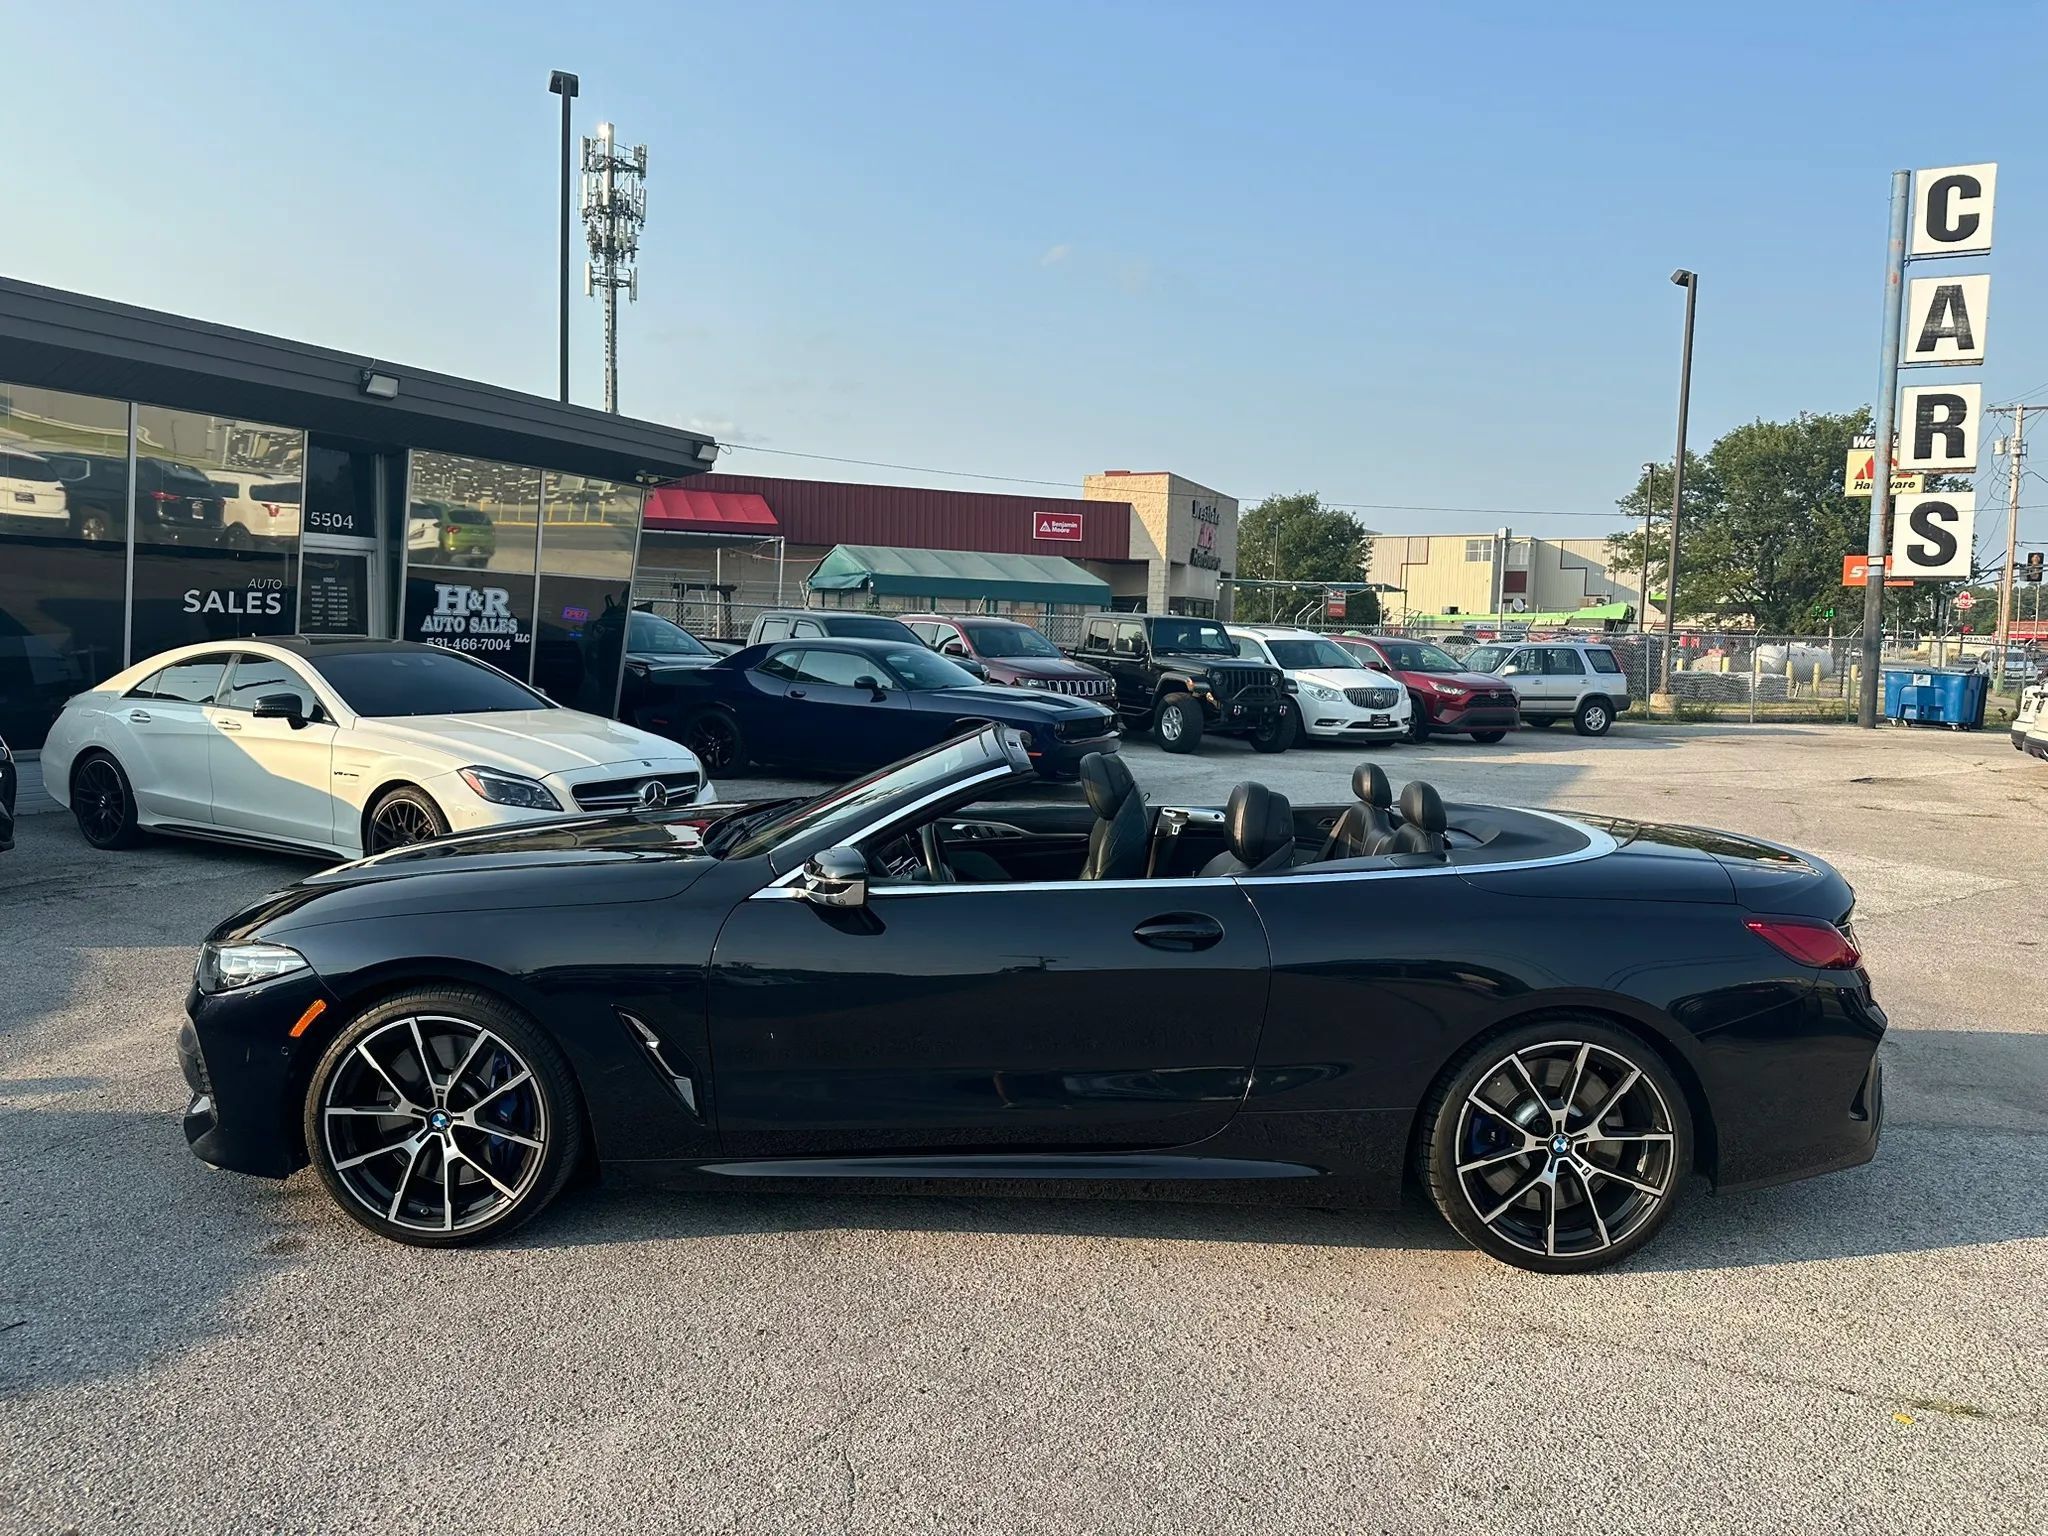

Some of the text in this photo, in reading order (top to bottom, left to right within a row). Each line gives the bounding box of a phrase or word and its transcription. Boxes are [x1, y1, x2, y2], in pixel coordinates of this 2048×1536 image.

[1906, 173, 1982, 567] CARS
[310, 511, 354, 529] 5504
[247, 578, 283, 590] AUTO
[183, 589, 282, 615] SALES
[433, 584, 511, 618] H&R
[420, 615, 518, 634] AUTO SALES
[514, 633, 531, 644] LLC
